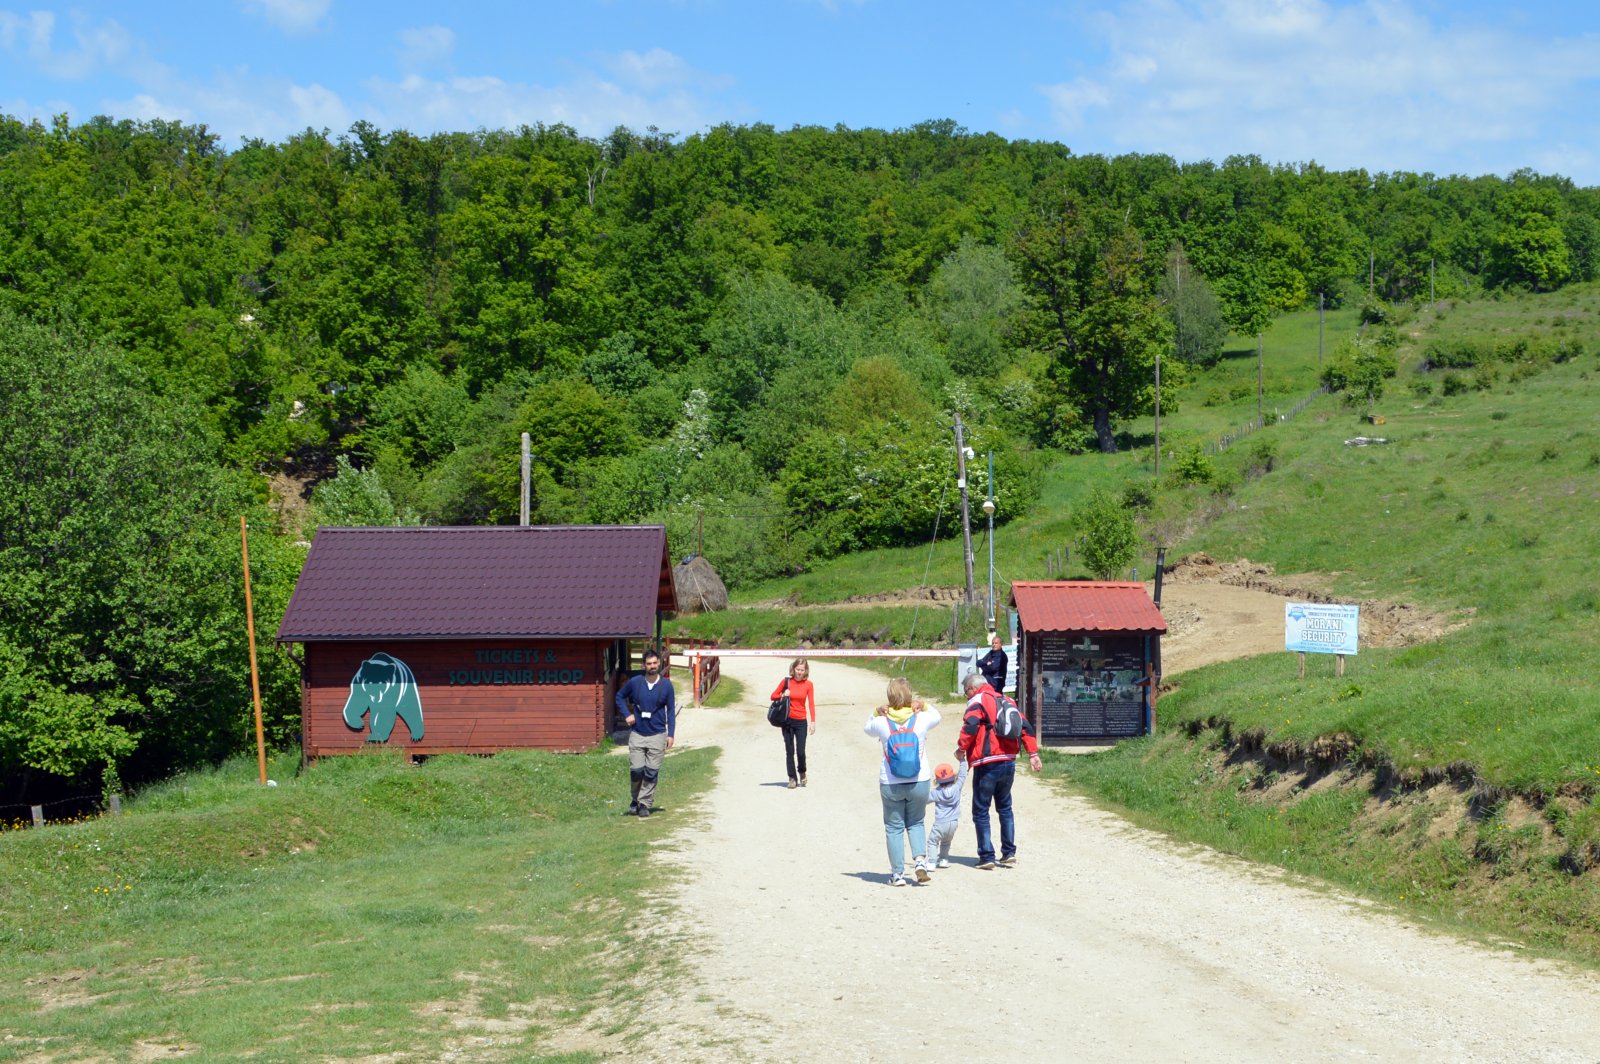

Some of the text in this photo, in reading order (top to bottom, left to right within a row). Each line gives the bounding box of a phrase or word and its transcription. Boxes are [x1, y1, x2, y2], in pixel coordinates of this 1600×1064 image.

[1306, 617, 1343, 631] MORANI
[1302, 630, 1347, 644] SECURITY
[475, 649, 557, 663] TICKETS &
[449, 669, 584, 684] SOUVENIR SHOP
